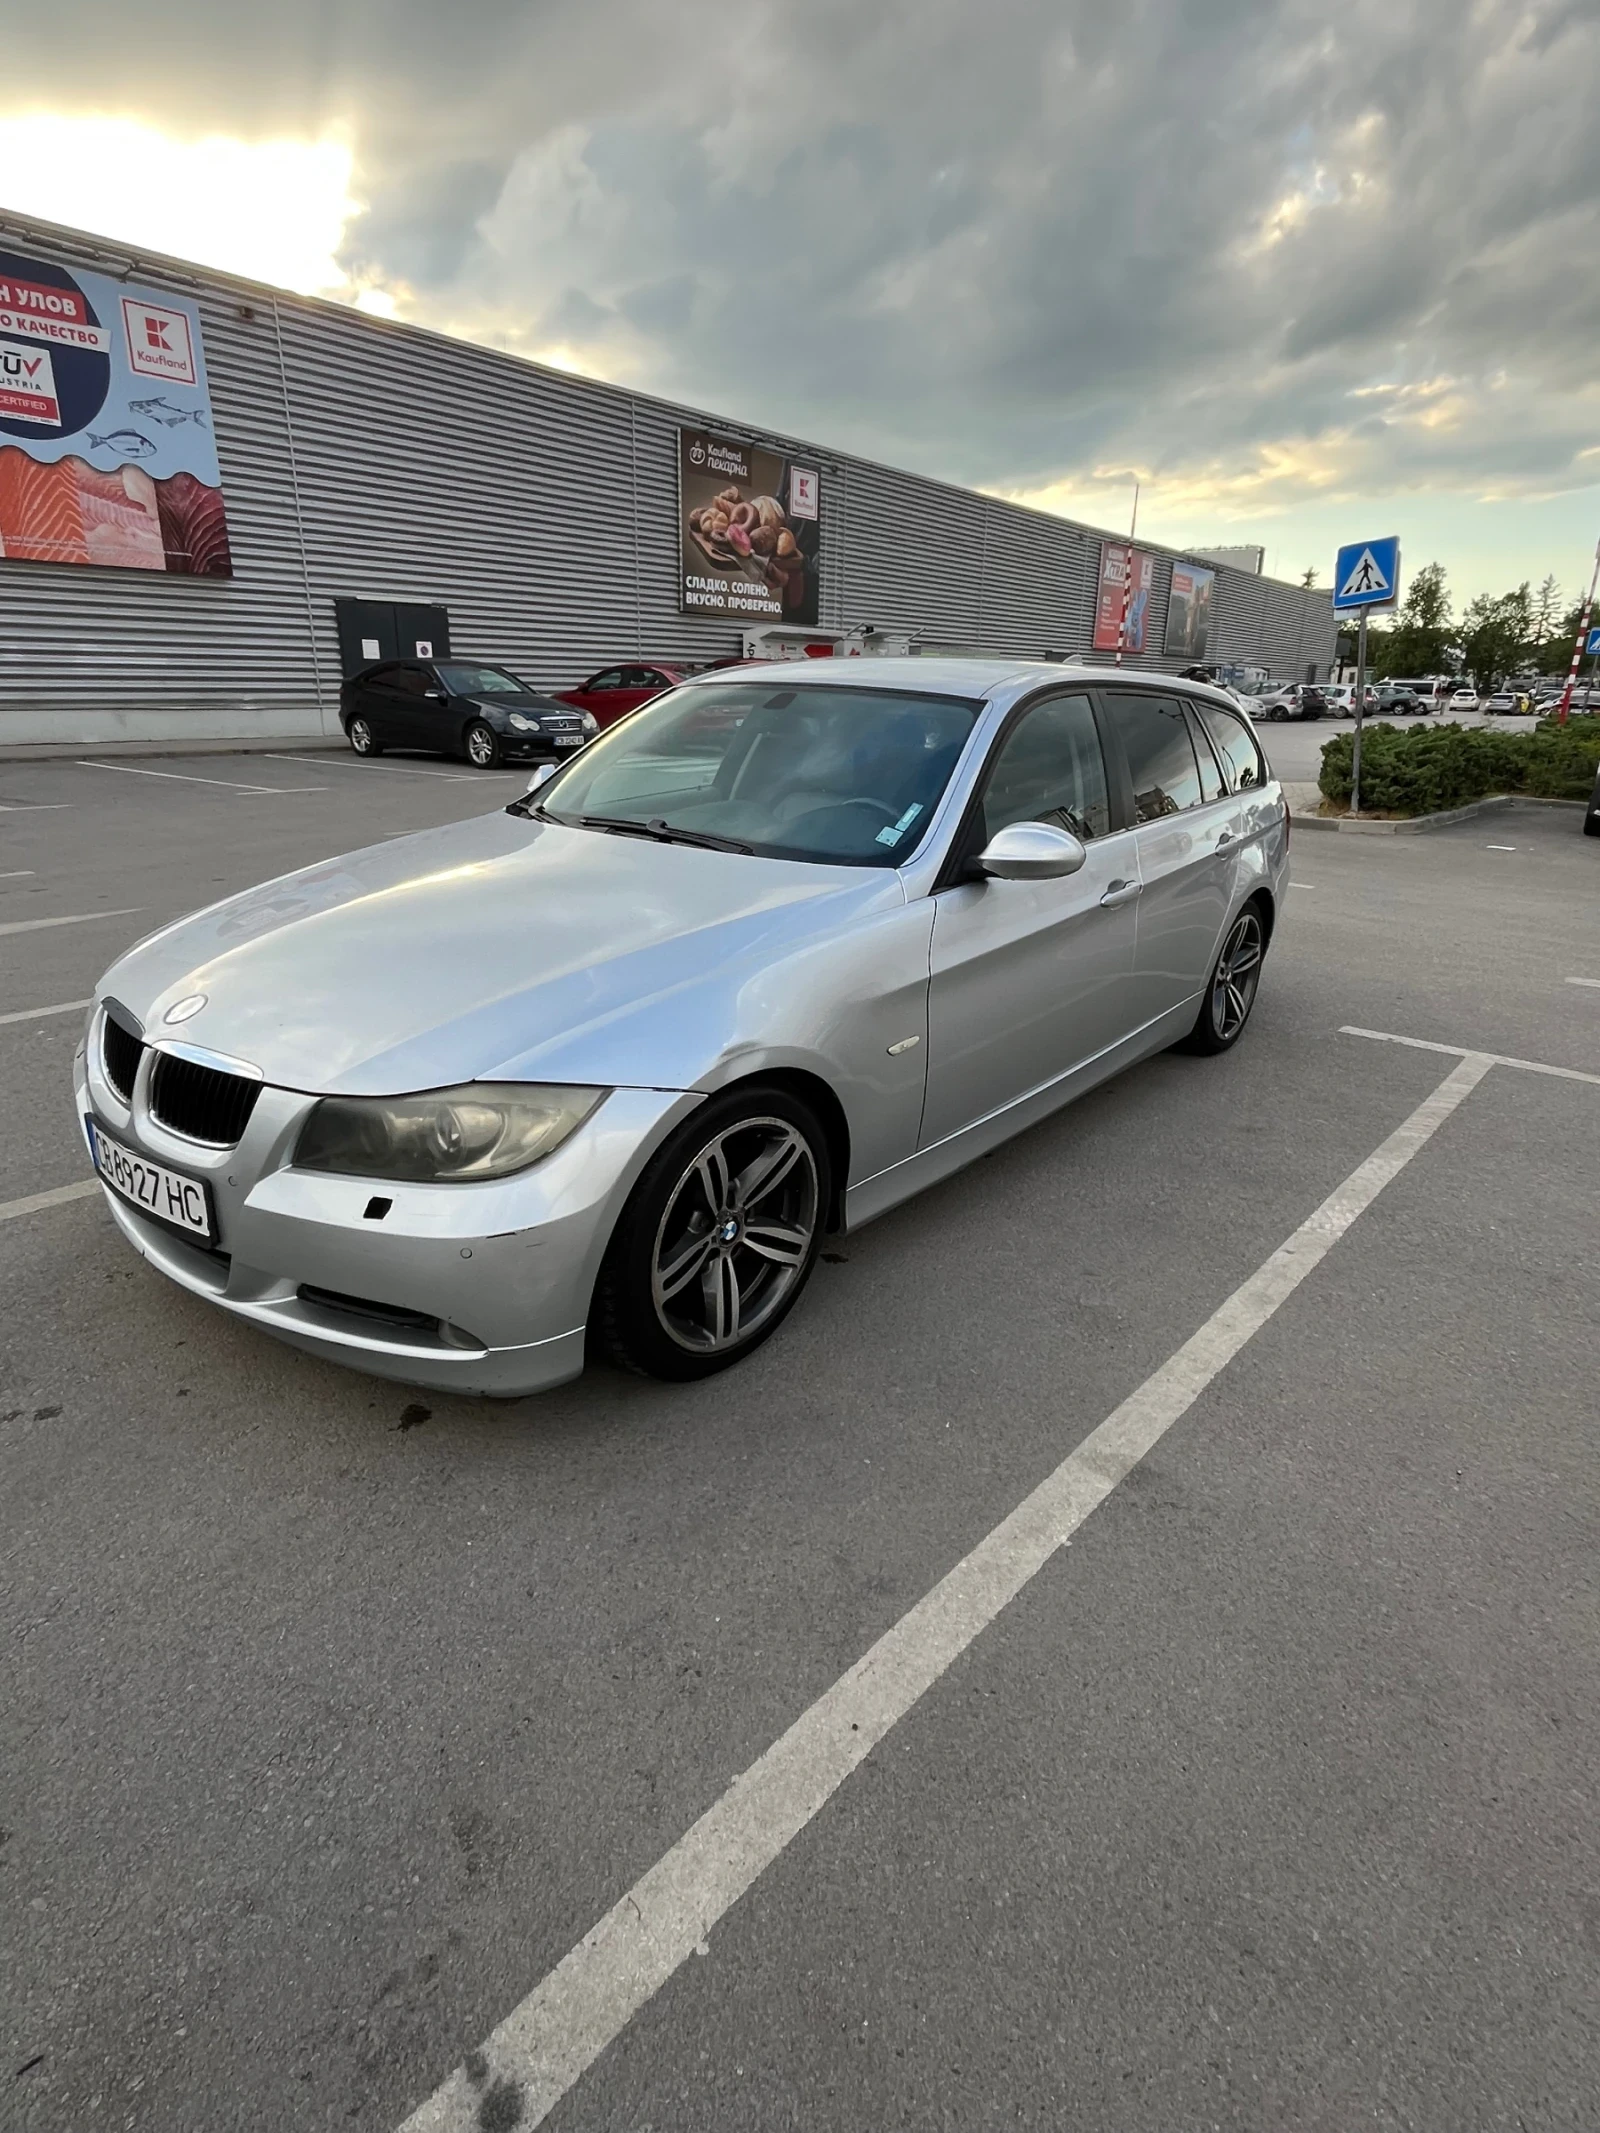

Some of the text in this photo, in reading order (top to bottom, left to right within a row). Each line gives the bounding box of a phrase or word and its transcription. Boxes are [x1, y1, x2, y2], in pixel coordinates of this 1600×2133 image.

[15, 287, 77, 316] УЛОВ
[16, 317, 99, 345] КАЧЕСТВО
[137, 350, 187, 370] Kaufland
[707, 443, 742, 462] Kaufland
[685, 575, 770, 597] СЛАДКО. СОЛЕНО.
[686, 592, 783, 613] ВКУСНО. ПРОВЕРЕНО.
[113, 1149, 160, 1207] 8927
[165, 1175, 203, 1226] HC
